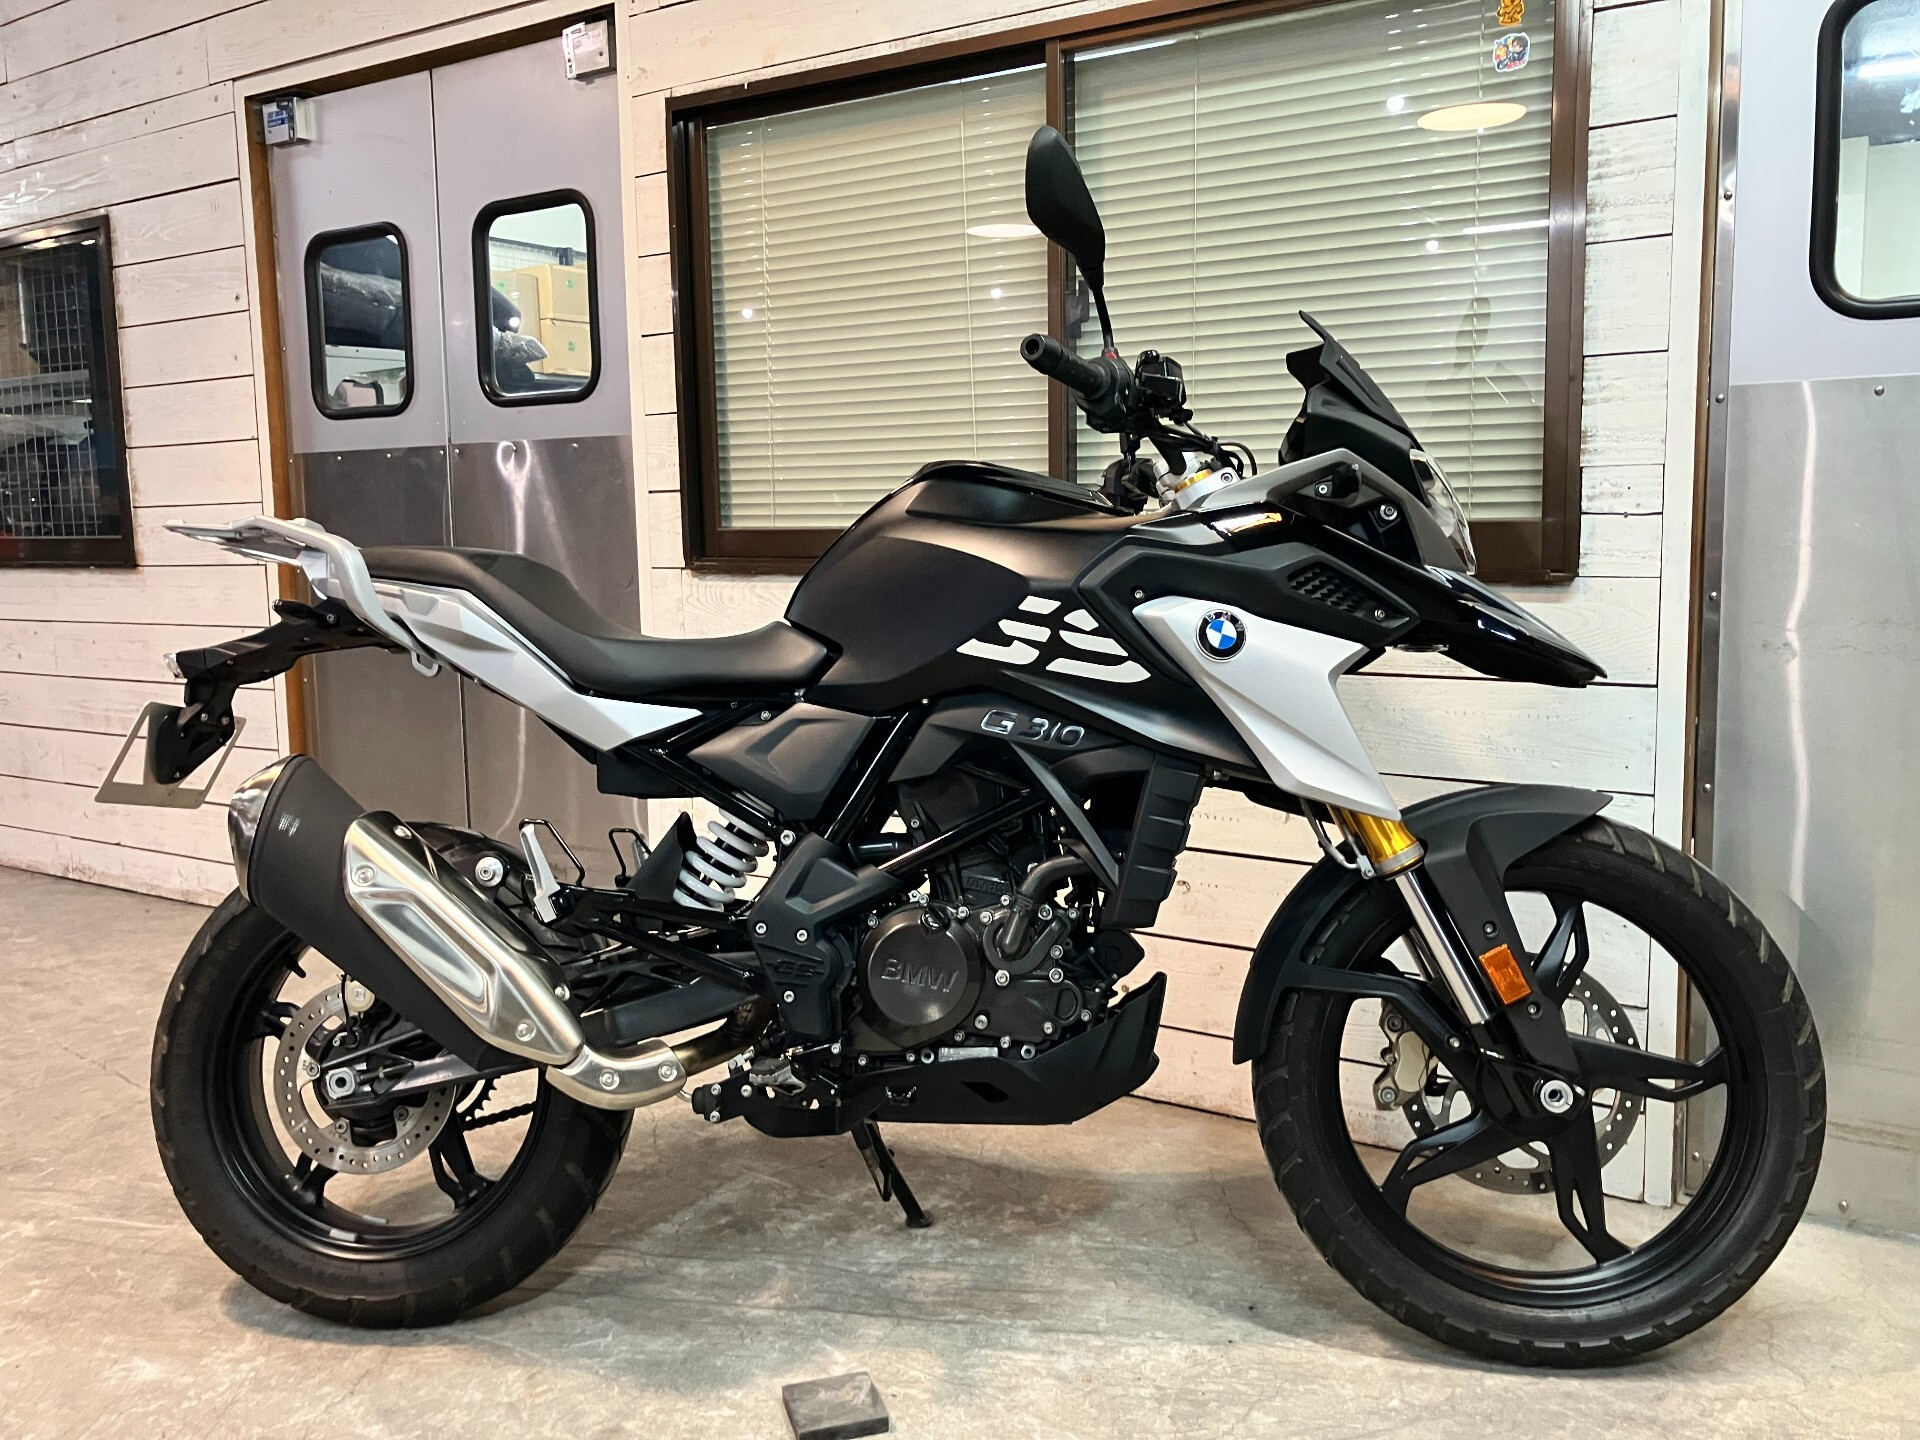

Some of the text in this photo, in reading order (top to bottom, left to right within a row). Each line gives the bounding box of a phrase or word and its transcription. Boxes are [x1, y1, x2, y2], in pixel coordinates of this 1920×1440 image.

[1205, 611, 1245, 632] BMW
[980, 709, 1085, 748] G 310
[881, 959, 959, 993] BMW
